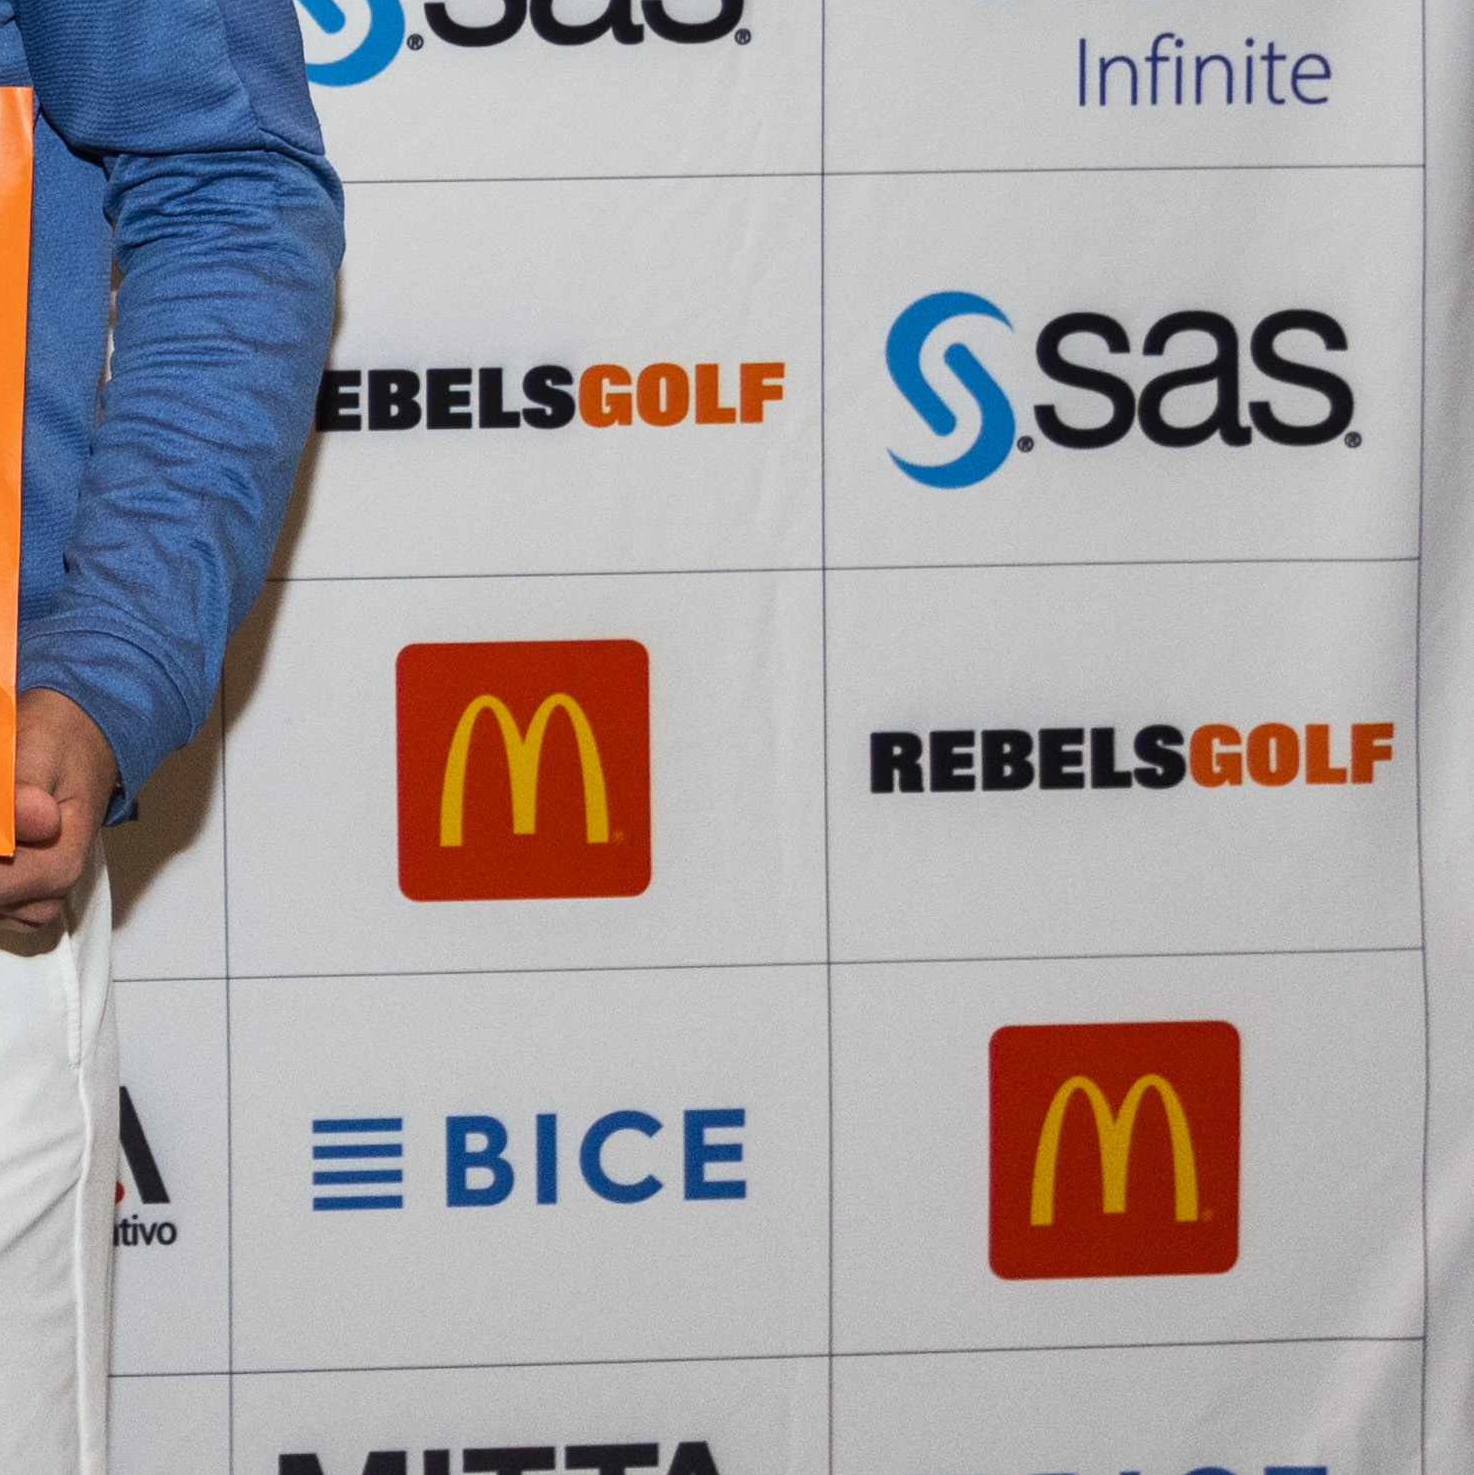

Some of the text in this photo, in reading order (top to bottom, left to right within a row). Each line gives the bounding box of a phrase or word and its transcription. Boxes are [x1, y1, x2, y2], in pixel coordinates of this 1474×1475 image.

[1079, 32, 1332, 107] Infinite
[315, 362, 786, 432] EBELSGOLF
[445, 1107, 747, 1208] BICE
